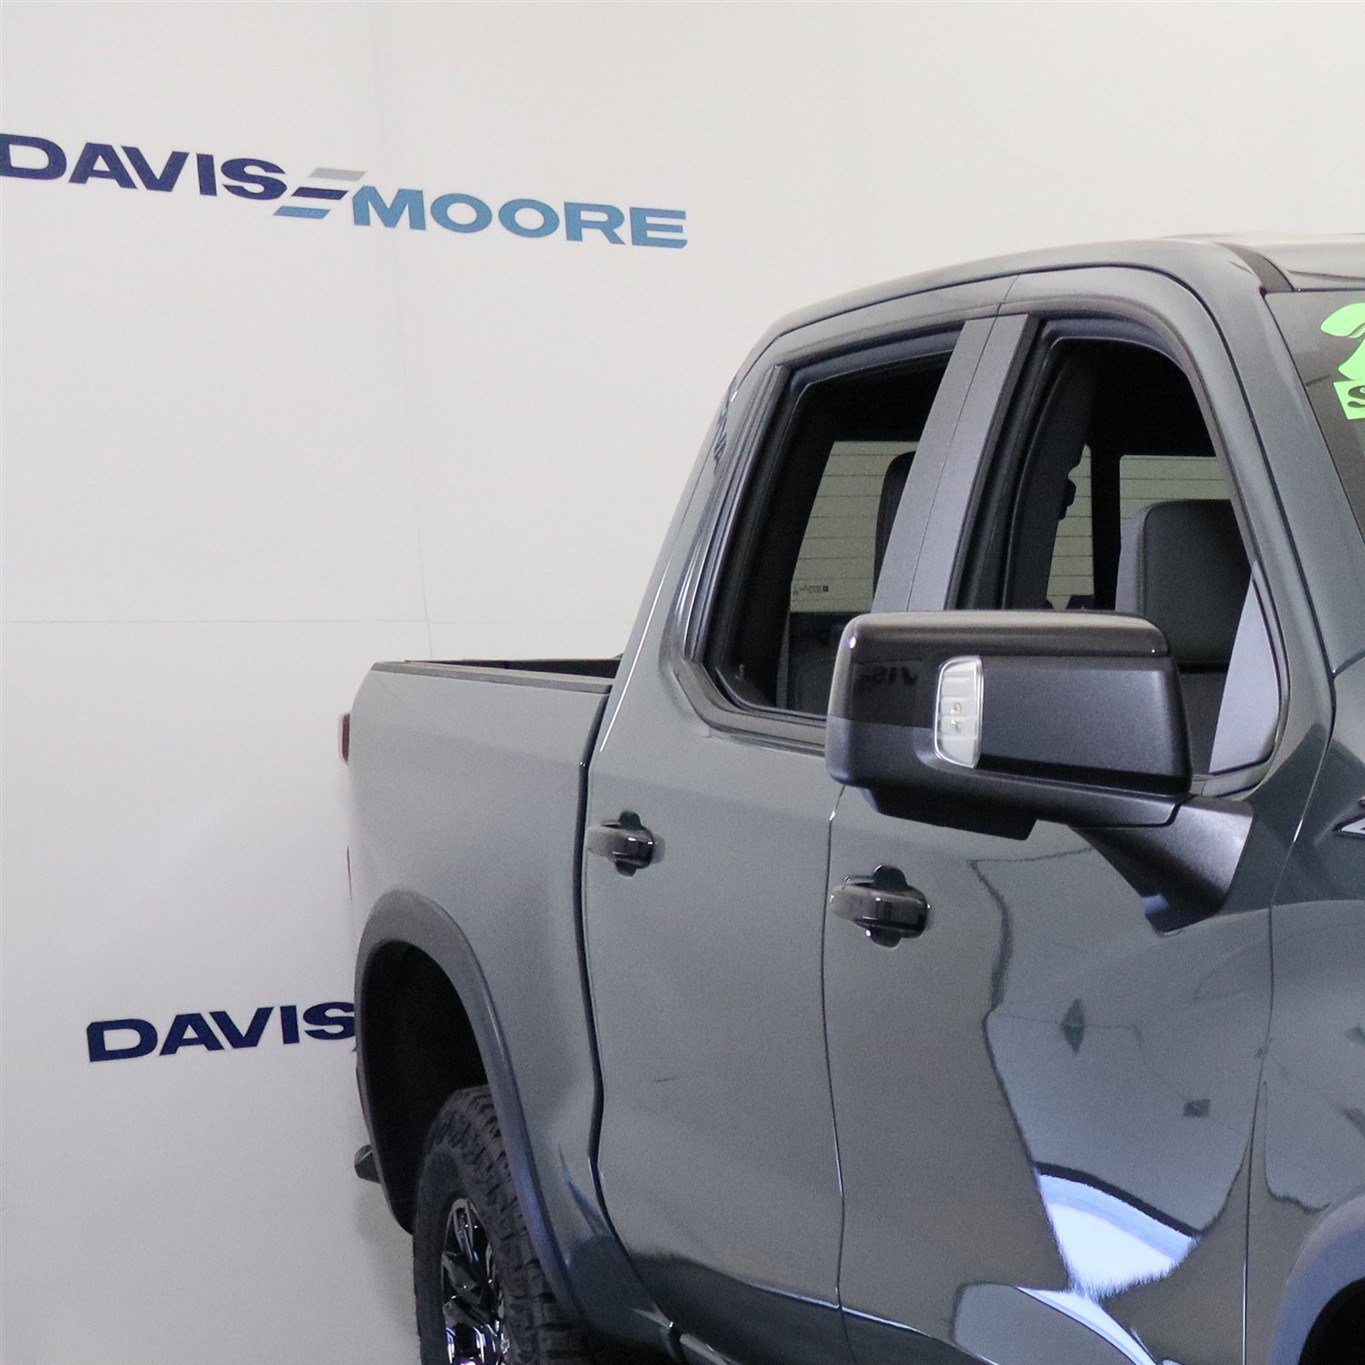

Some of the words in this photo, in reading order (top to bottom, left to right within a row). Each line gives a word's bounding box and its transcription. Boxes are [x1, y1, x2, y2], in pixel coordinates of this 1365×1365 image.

[0, 133, 288, 201] DAVIS
[352, 186, 688, 249] MOORE
[86, 1001, 356, 1063] DAVIS
